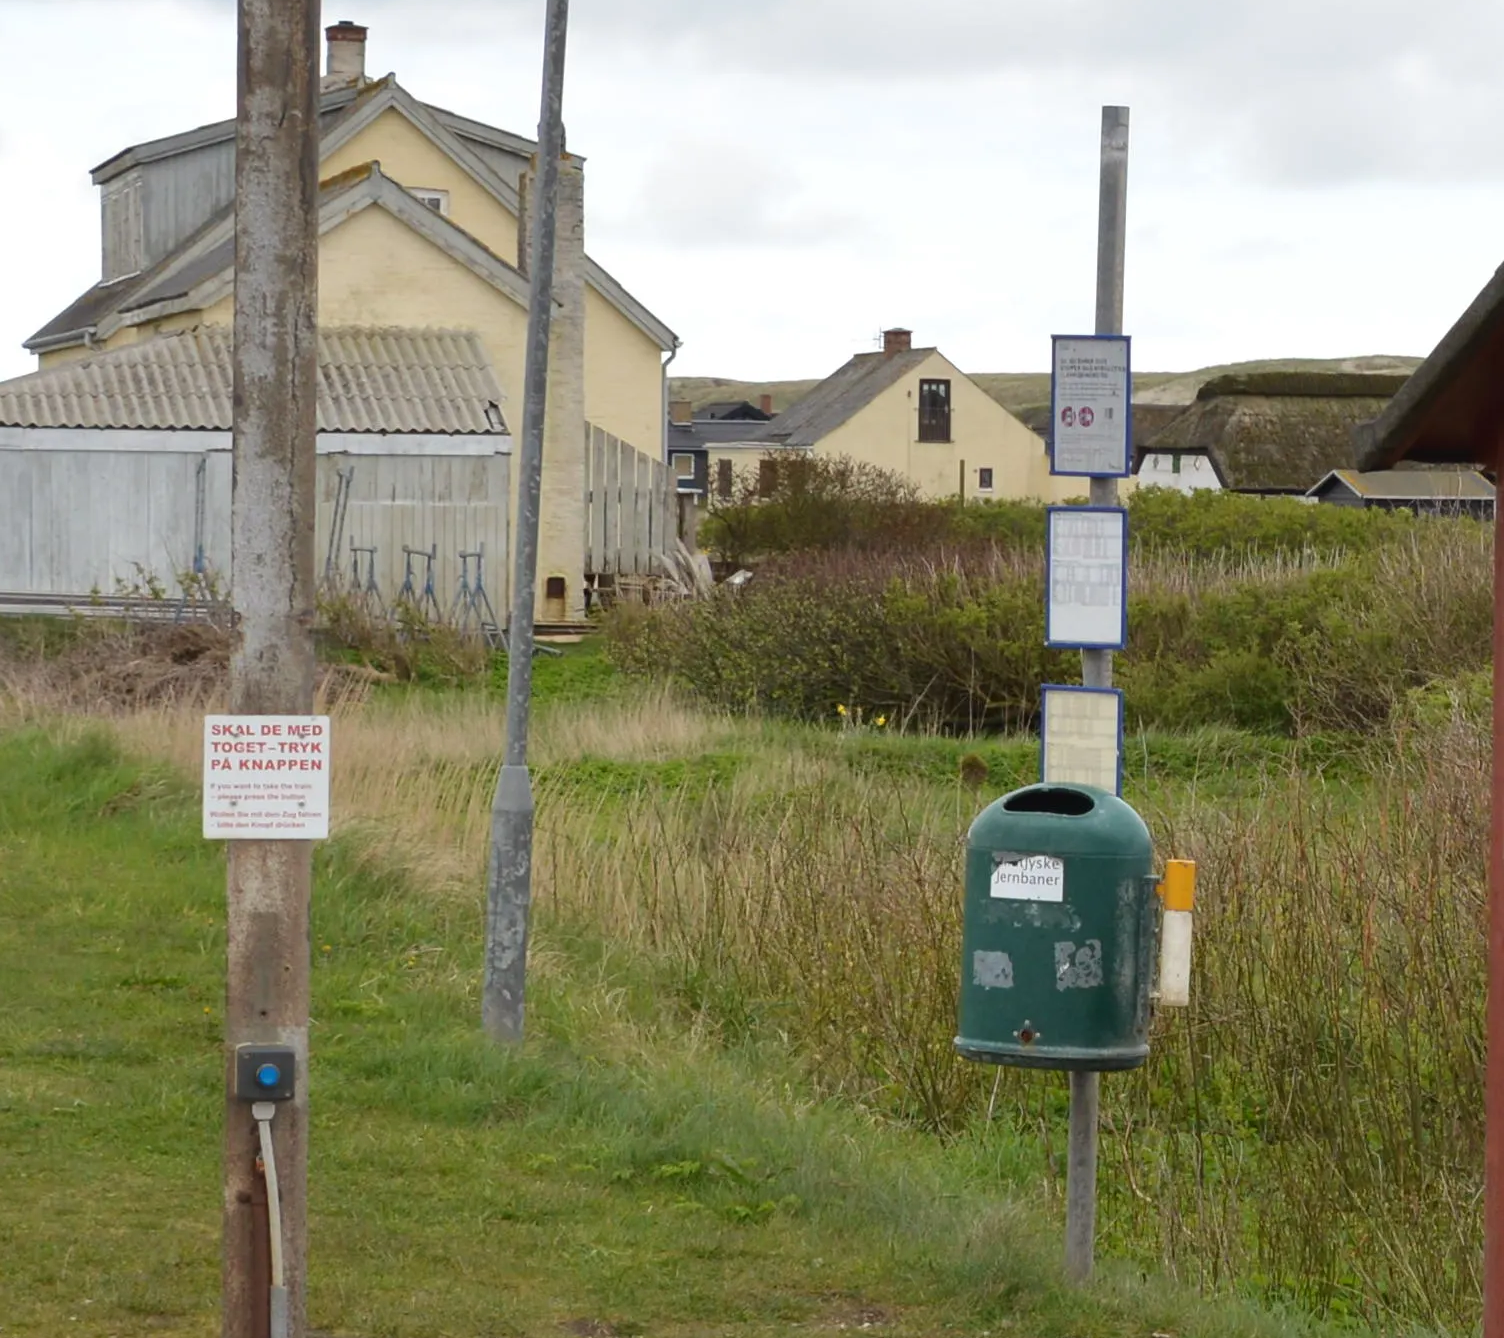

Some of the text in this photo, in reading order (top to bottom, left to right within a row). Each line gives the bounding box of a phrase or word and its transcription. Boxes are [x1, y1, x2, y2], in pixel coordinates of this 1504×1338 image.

[211, 724, 323, 737] SKAL DE MED
[211, 757, 322, 771] PÅ KNAPPEN
[994, 870, 1060, 886] Jernbaner
